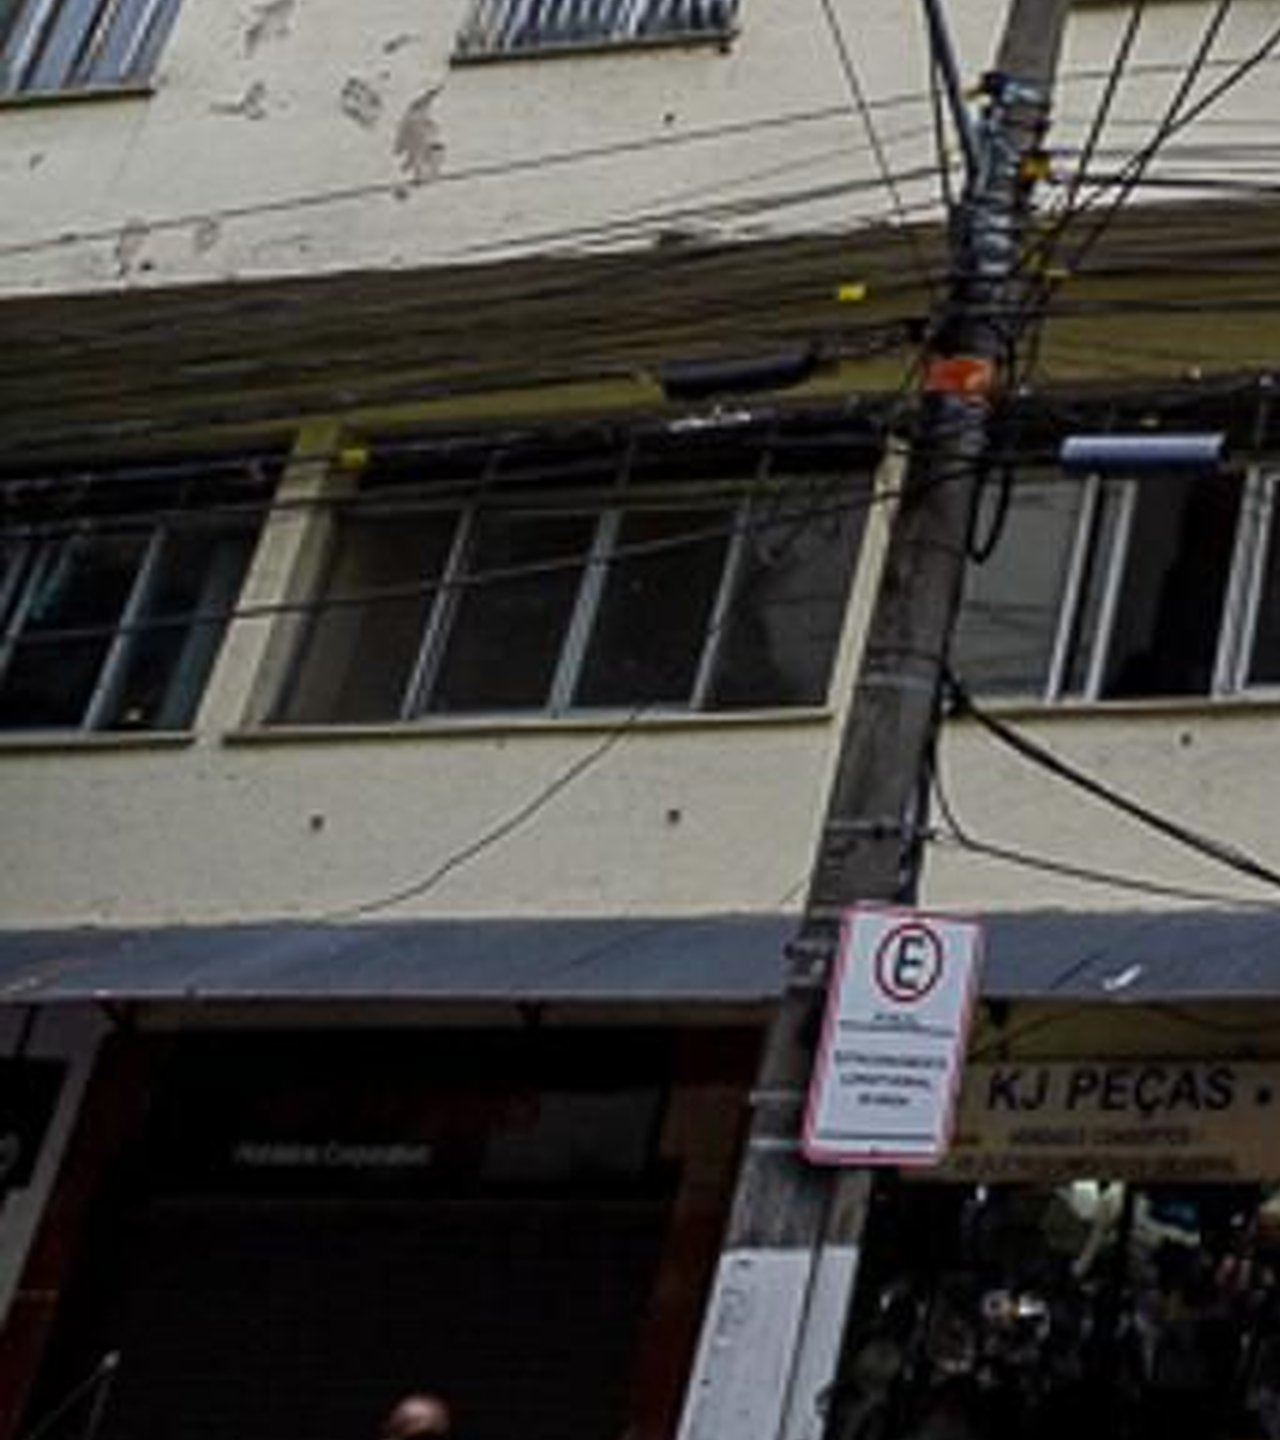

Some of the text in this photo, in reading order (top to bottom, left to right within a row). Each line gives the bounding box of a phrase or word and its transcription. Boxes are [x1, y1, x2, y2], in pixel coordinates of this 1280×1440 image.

[893, 934, 925, 989] E
[987, 1067, 1237, 1119] KJ PEÇAS
